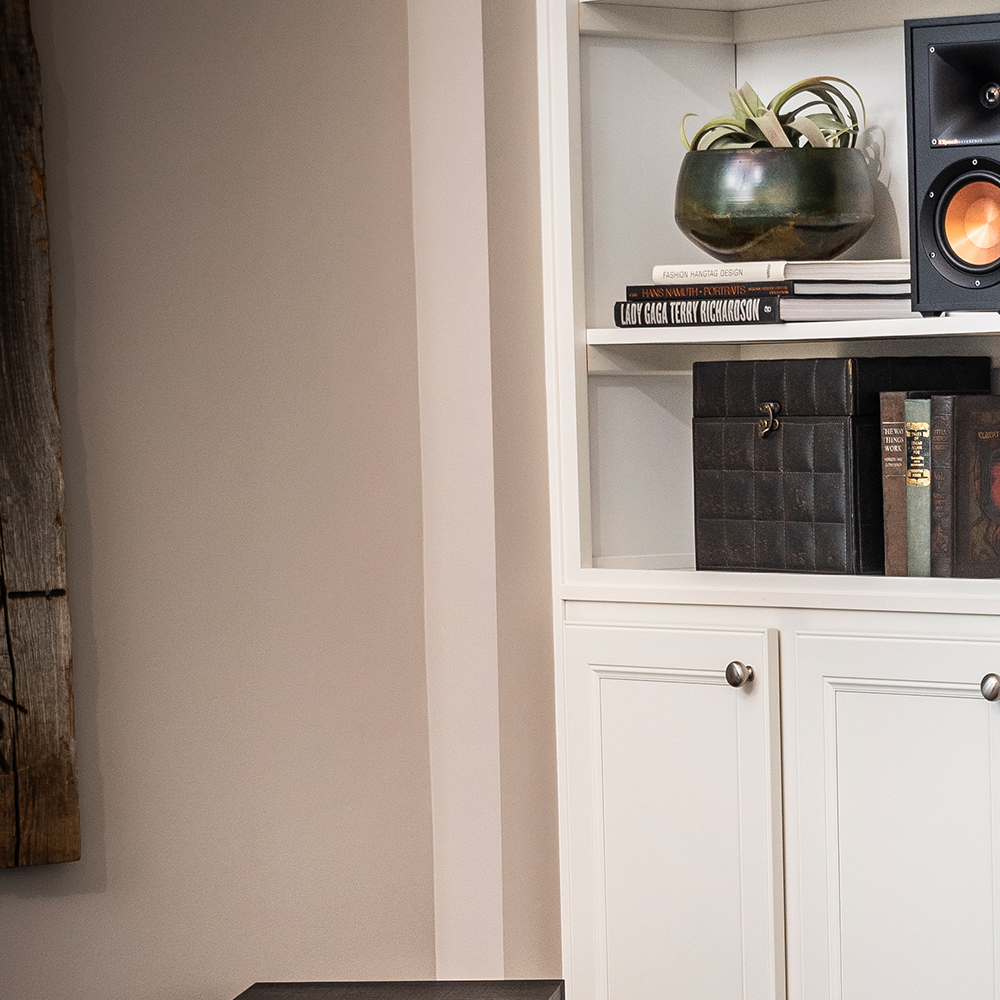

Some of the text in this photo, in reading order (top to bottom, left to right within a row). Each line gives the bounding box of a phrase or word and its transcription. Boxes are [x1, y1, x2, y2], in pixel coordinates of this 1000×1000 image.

[662, 268, 743, 279] FASHION HANGTAG DESIGN
[642, 288, 664, 298] HANS
[665, 287, 698, 298] NAMUTH
[703, 285, 746, 296] PORTRAITS
[621, 298, 761, 325] LADY GAGA TERRY RICHARDSON
[883, 436, 904, 444] THINGS
